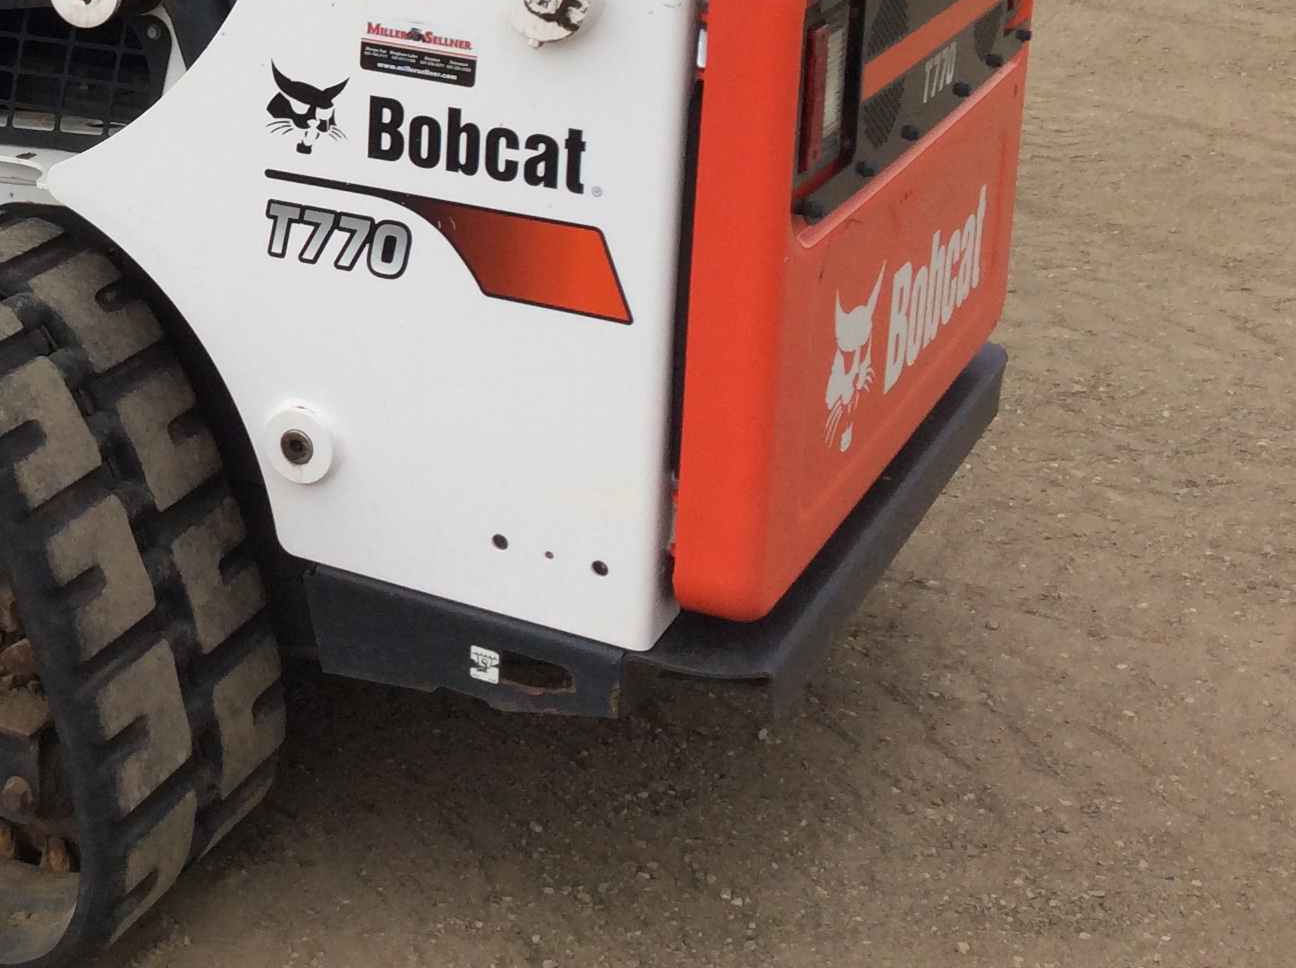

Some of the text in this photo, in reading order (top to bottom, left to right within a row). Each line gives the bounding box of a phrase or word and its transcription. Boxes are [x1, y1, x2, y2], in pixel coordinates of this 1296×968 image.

[424, 31, 472, 50] SELLNER
[923, 41, 957, 104] T770
[368, 95, 586, 195] Bobcat
[266, 199, 412, 280] T770
[883, 184, 987, 395] Bobcat
